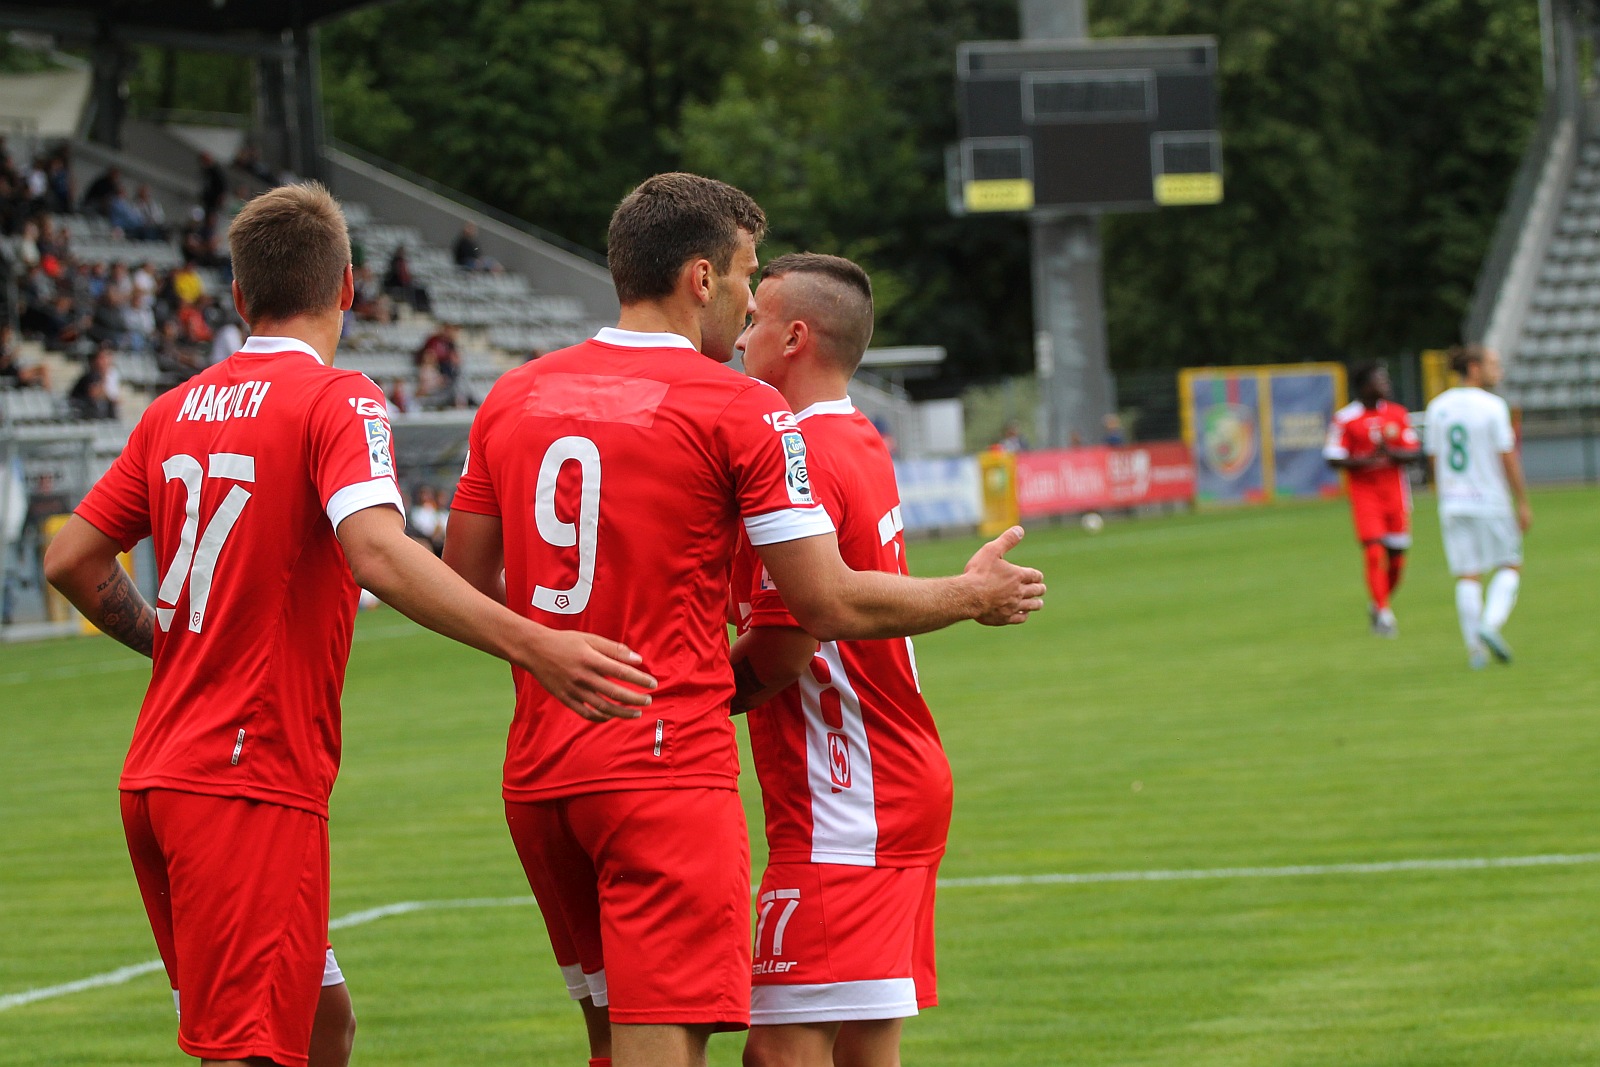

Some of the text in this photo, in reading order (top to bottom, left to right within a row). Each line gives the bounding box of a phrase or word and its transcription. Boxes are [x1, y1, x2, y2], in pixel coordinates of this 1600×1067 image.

[1446, 422, 1468, 474] 8
[531, 435, 602, 615] 9
[755, 888, 801, 959] 77
